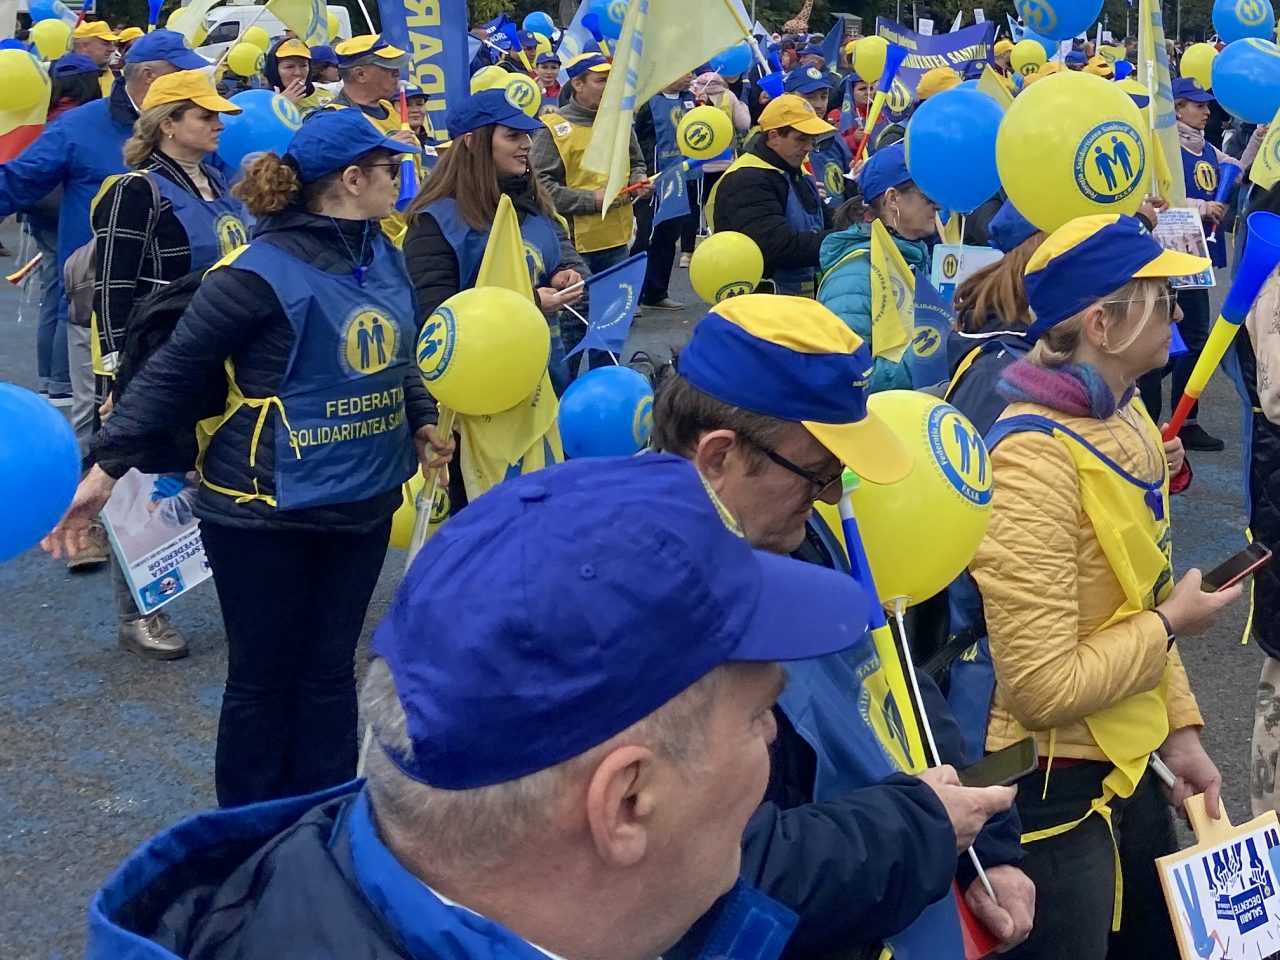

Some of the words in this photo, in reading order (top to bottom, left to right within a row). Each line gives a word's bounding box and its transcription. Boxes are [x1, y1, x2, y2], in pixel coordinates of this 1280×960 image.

[289, 416, 386, 448] SOLIDARITATEA
[1232, 894, 1262, 915] DECENTE
[1239, 906, 1264, 925] SALARII
